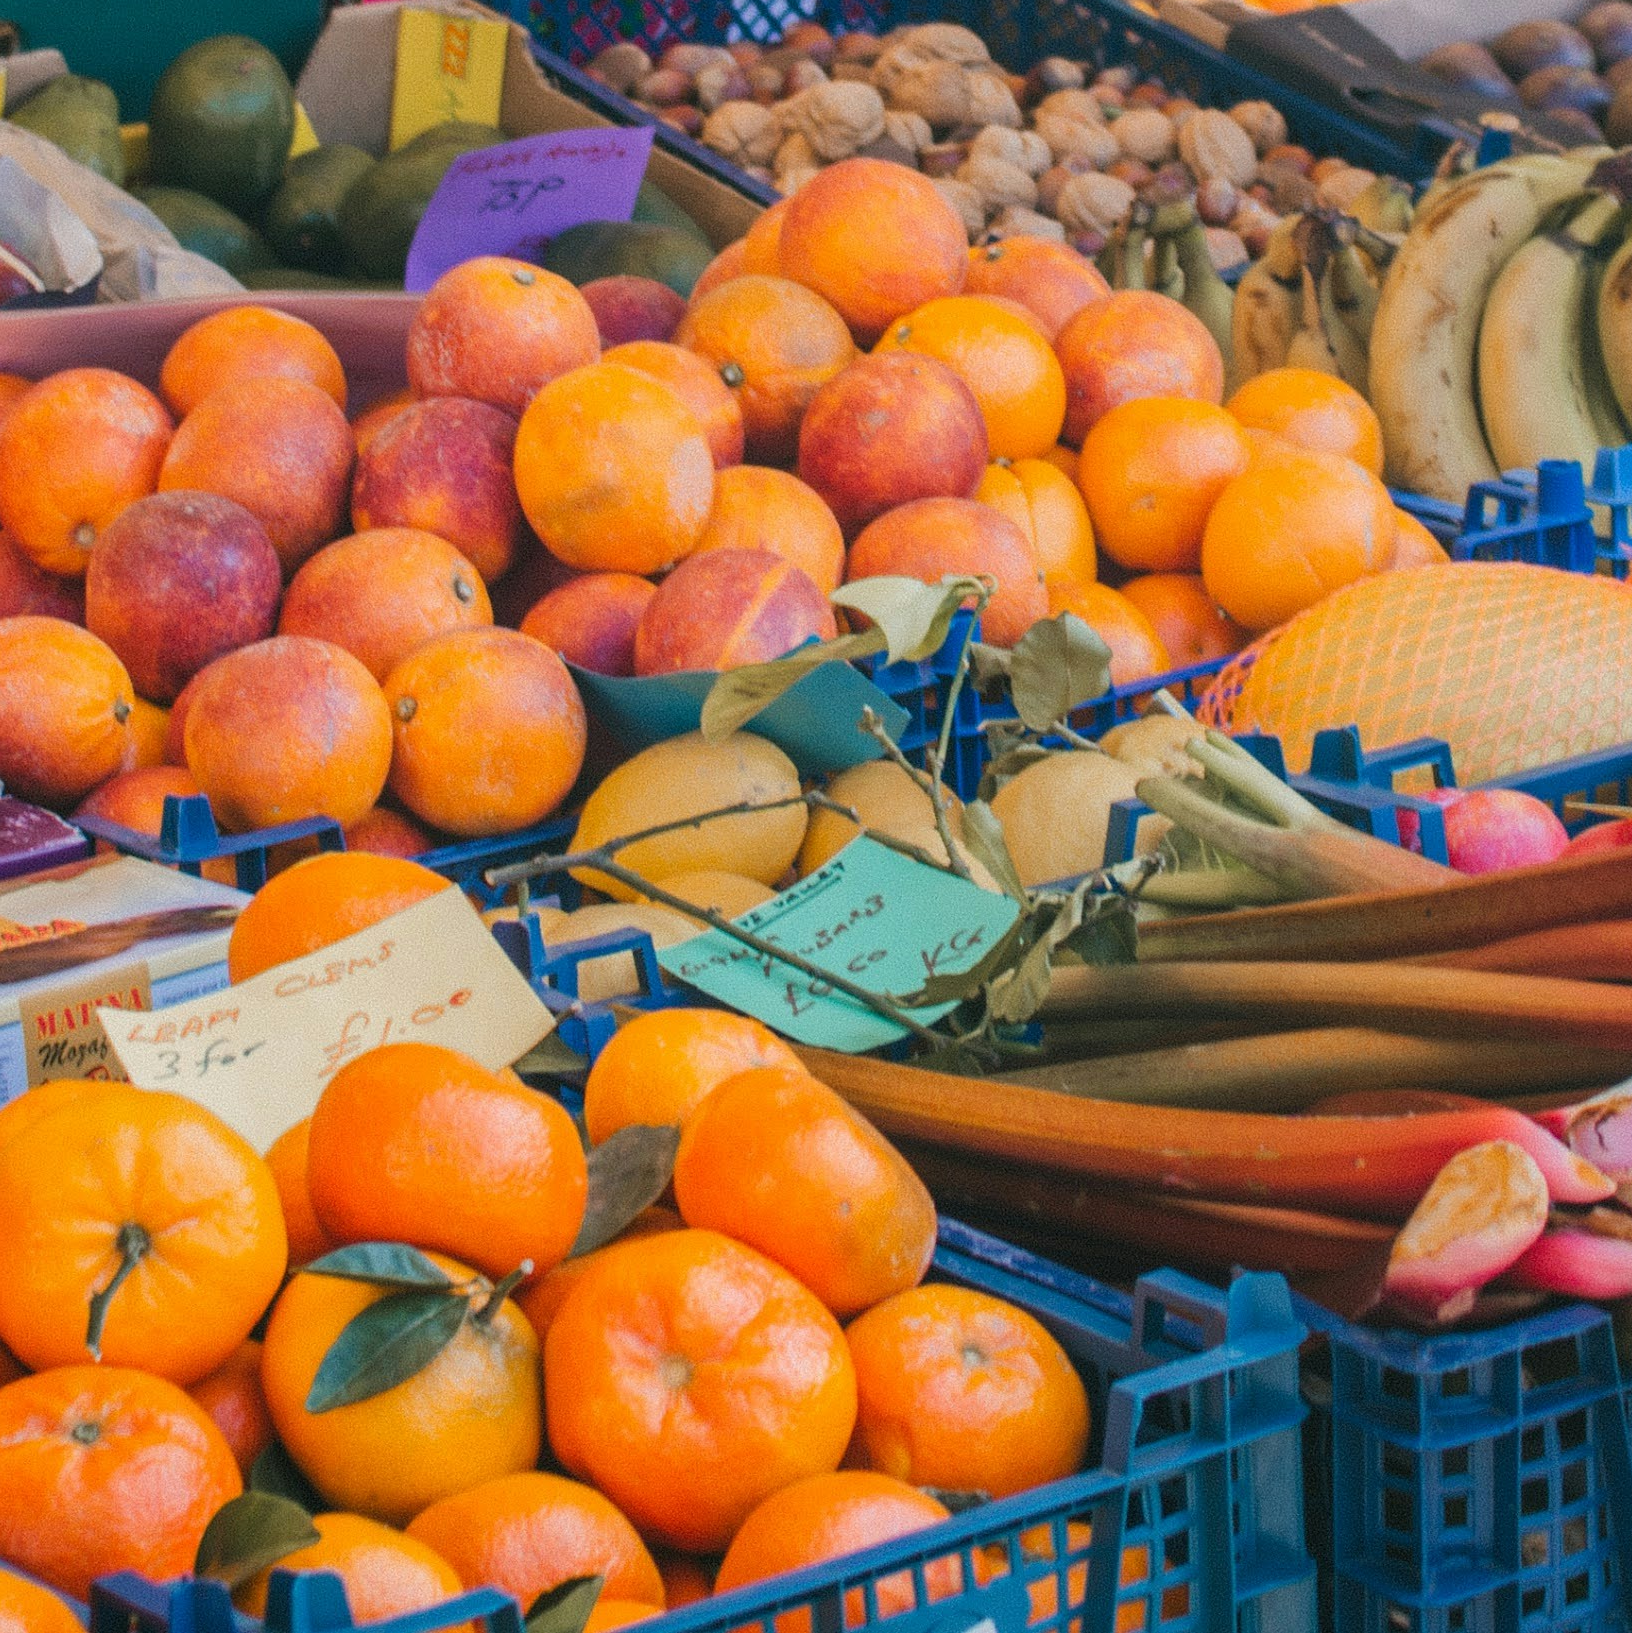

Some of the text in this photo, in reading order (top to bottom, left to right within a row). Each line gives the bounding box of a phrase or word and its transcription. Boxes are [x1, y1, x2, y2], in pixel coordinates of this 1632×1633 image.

[127, 941, 397, 1044] LEAFY CLEMS
[38, 1037, 109, 1068] Mozaf
[155, 1050, 182, 1081] 3
[196, 1037, 268, 1078] for
